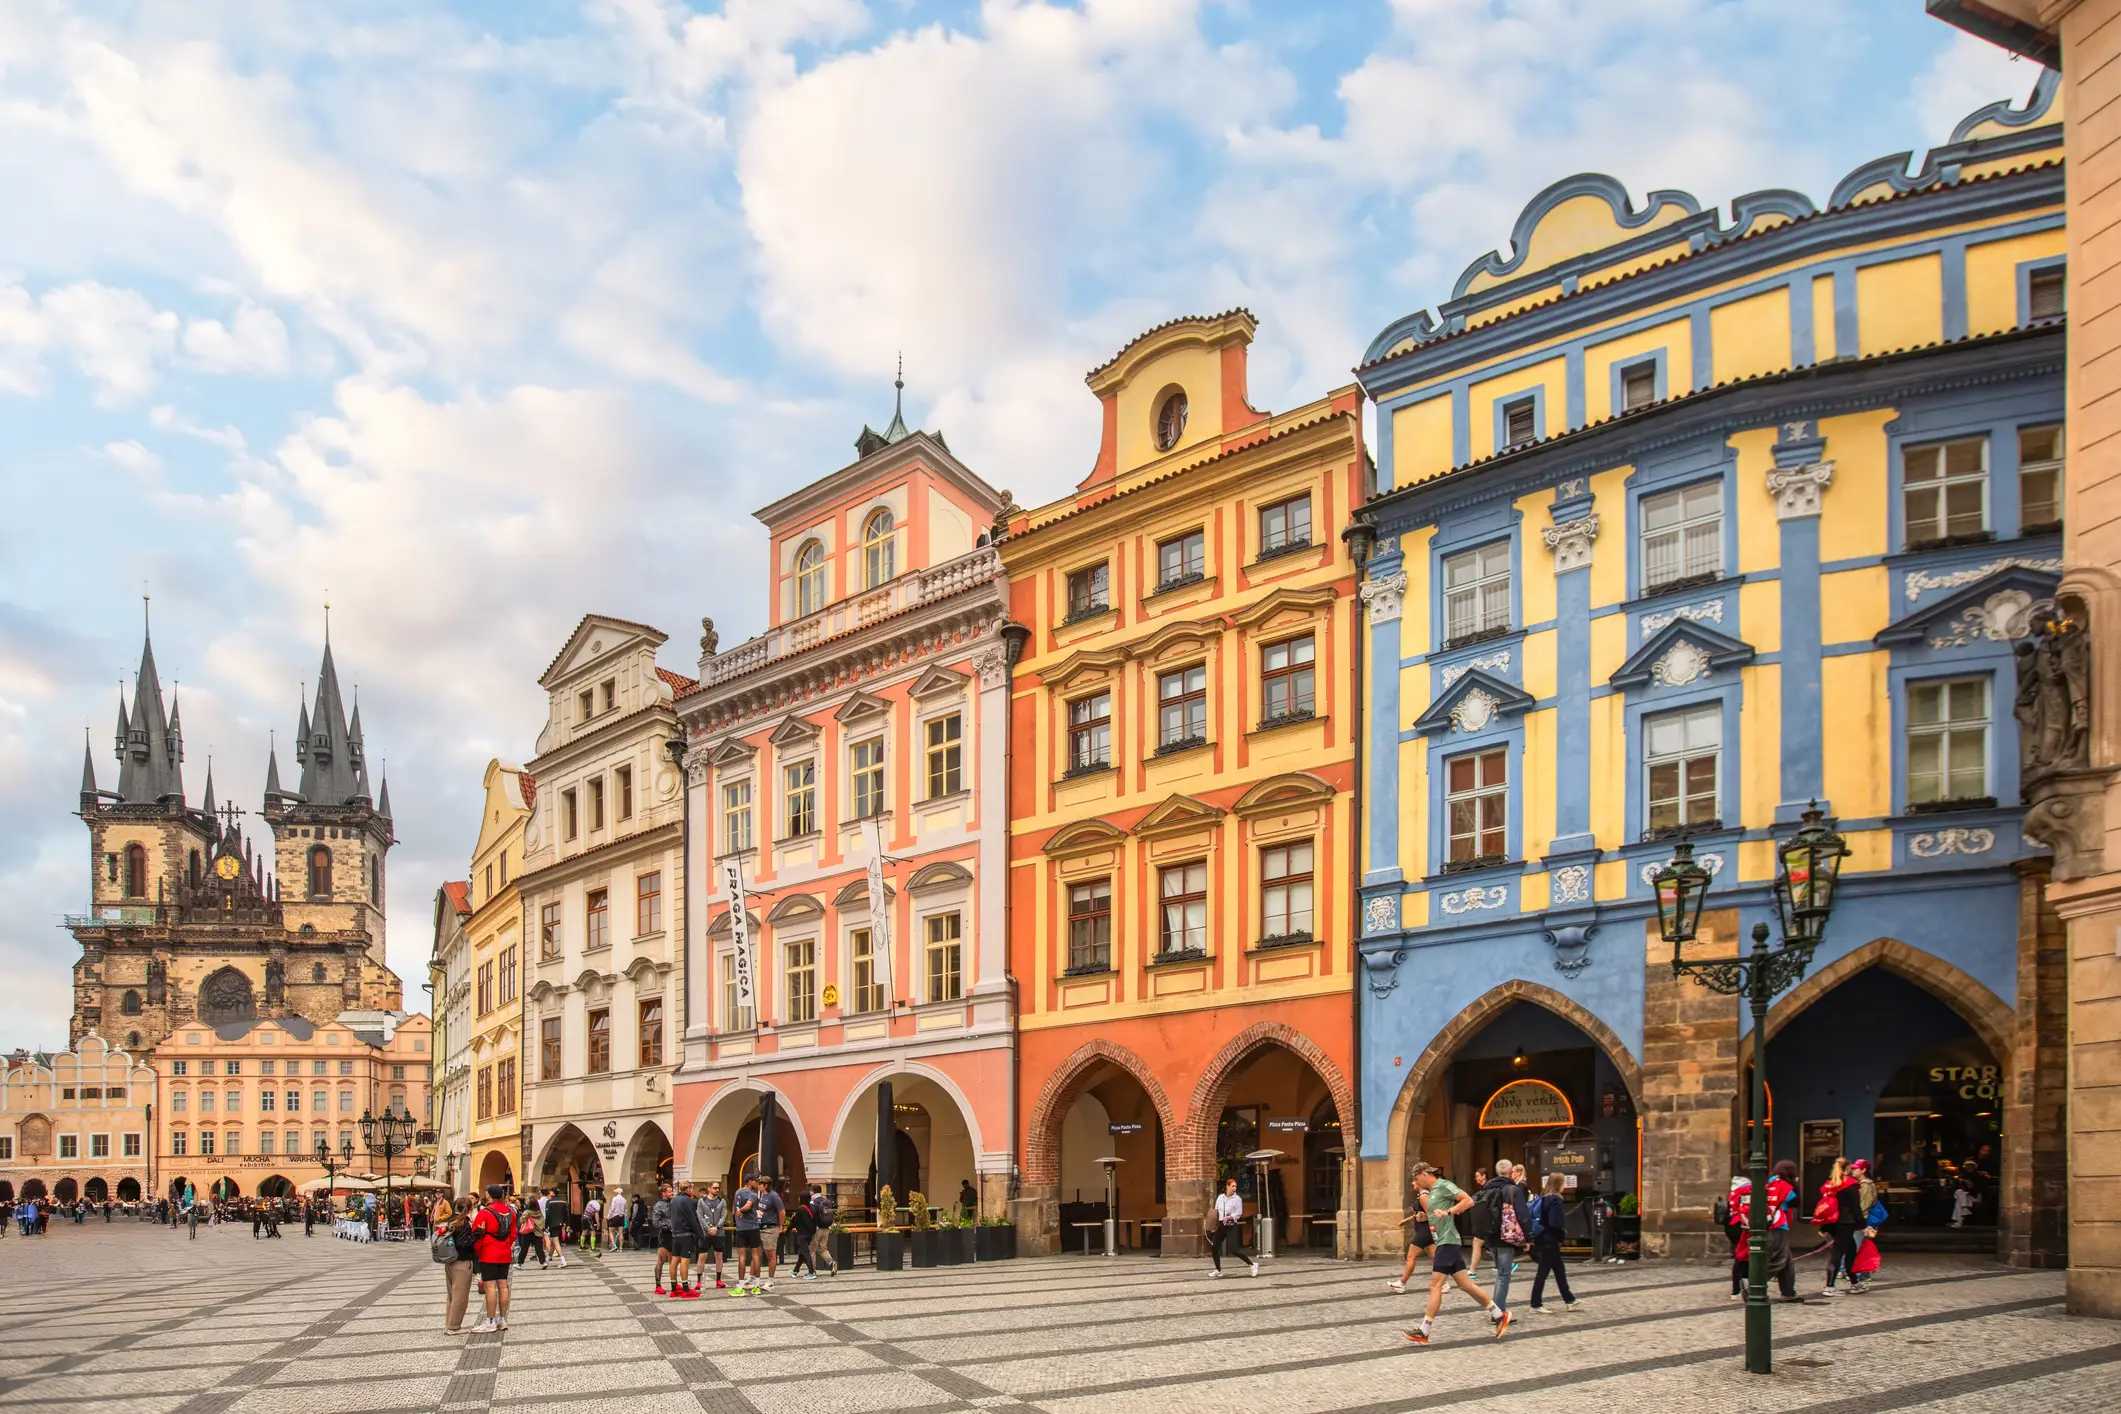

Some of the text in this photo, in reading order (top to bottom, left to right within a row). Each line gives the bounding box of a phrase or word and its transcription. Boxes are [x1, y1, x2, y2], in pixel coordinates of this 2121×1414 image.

[726, 867, 750, 998] PRAGA MAGICA
[1929, 1065, 1998, 1082] STAR
